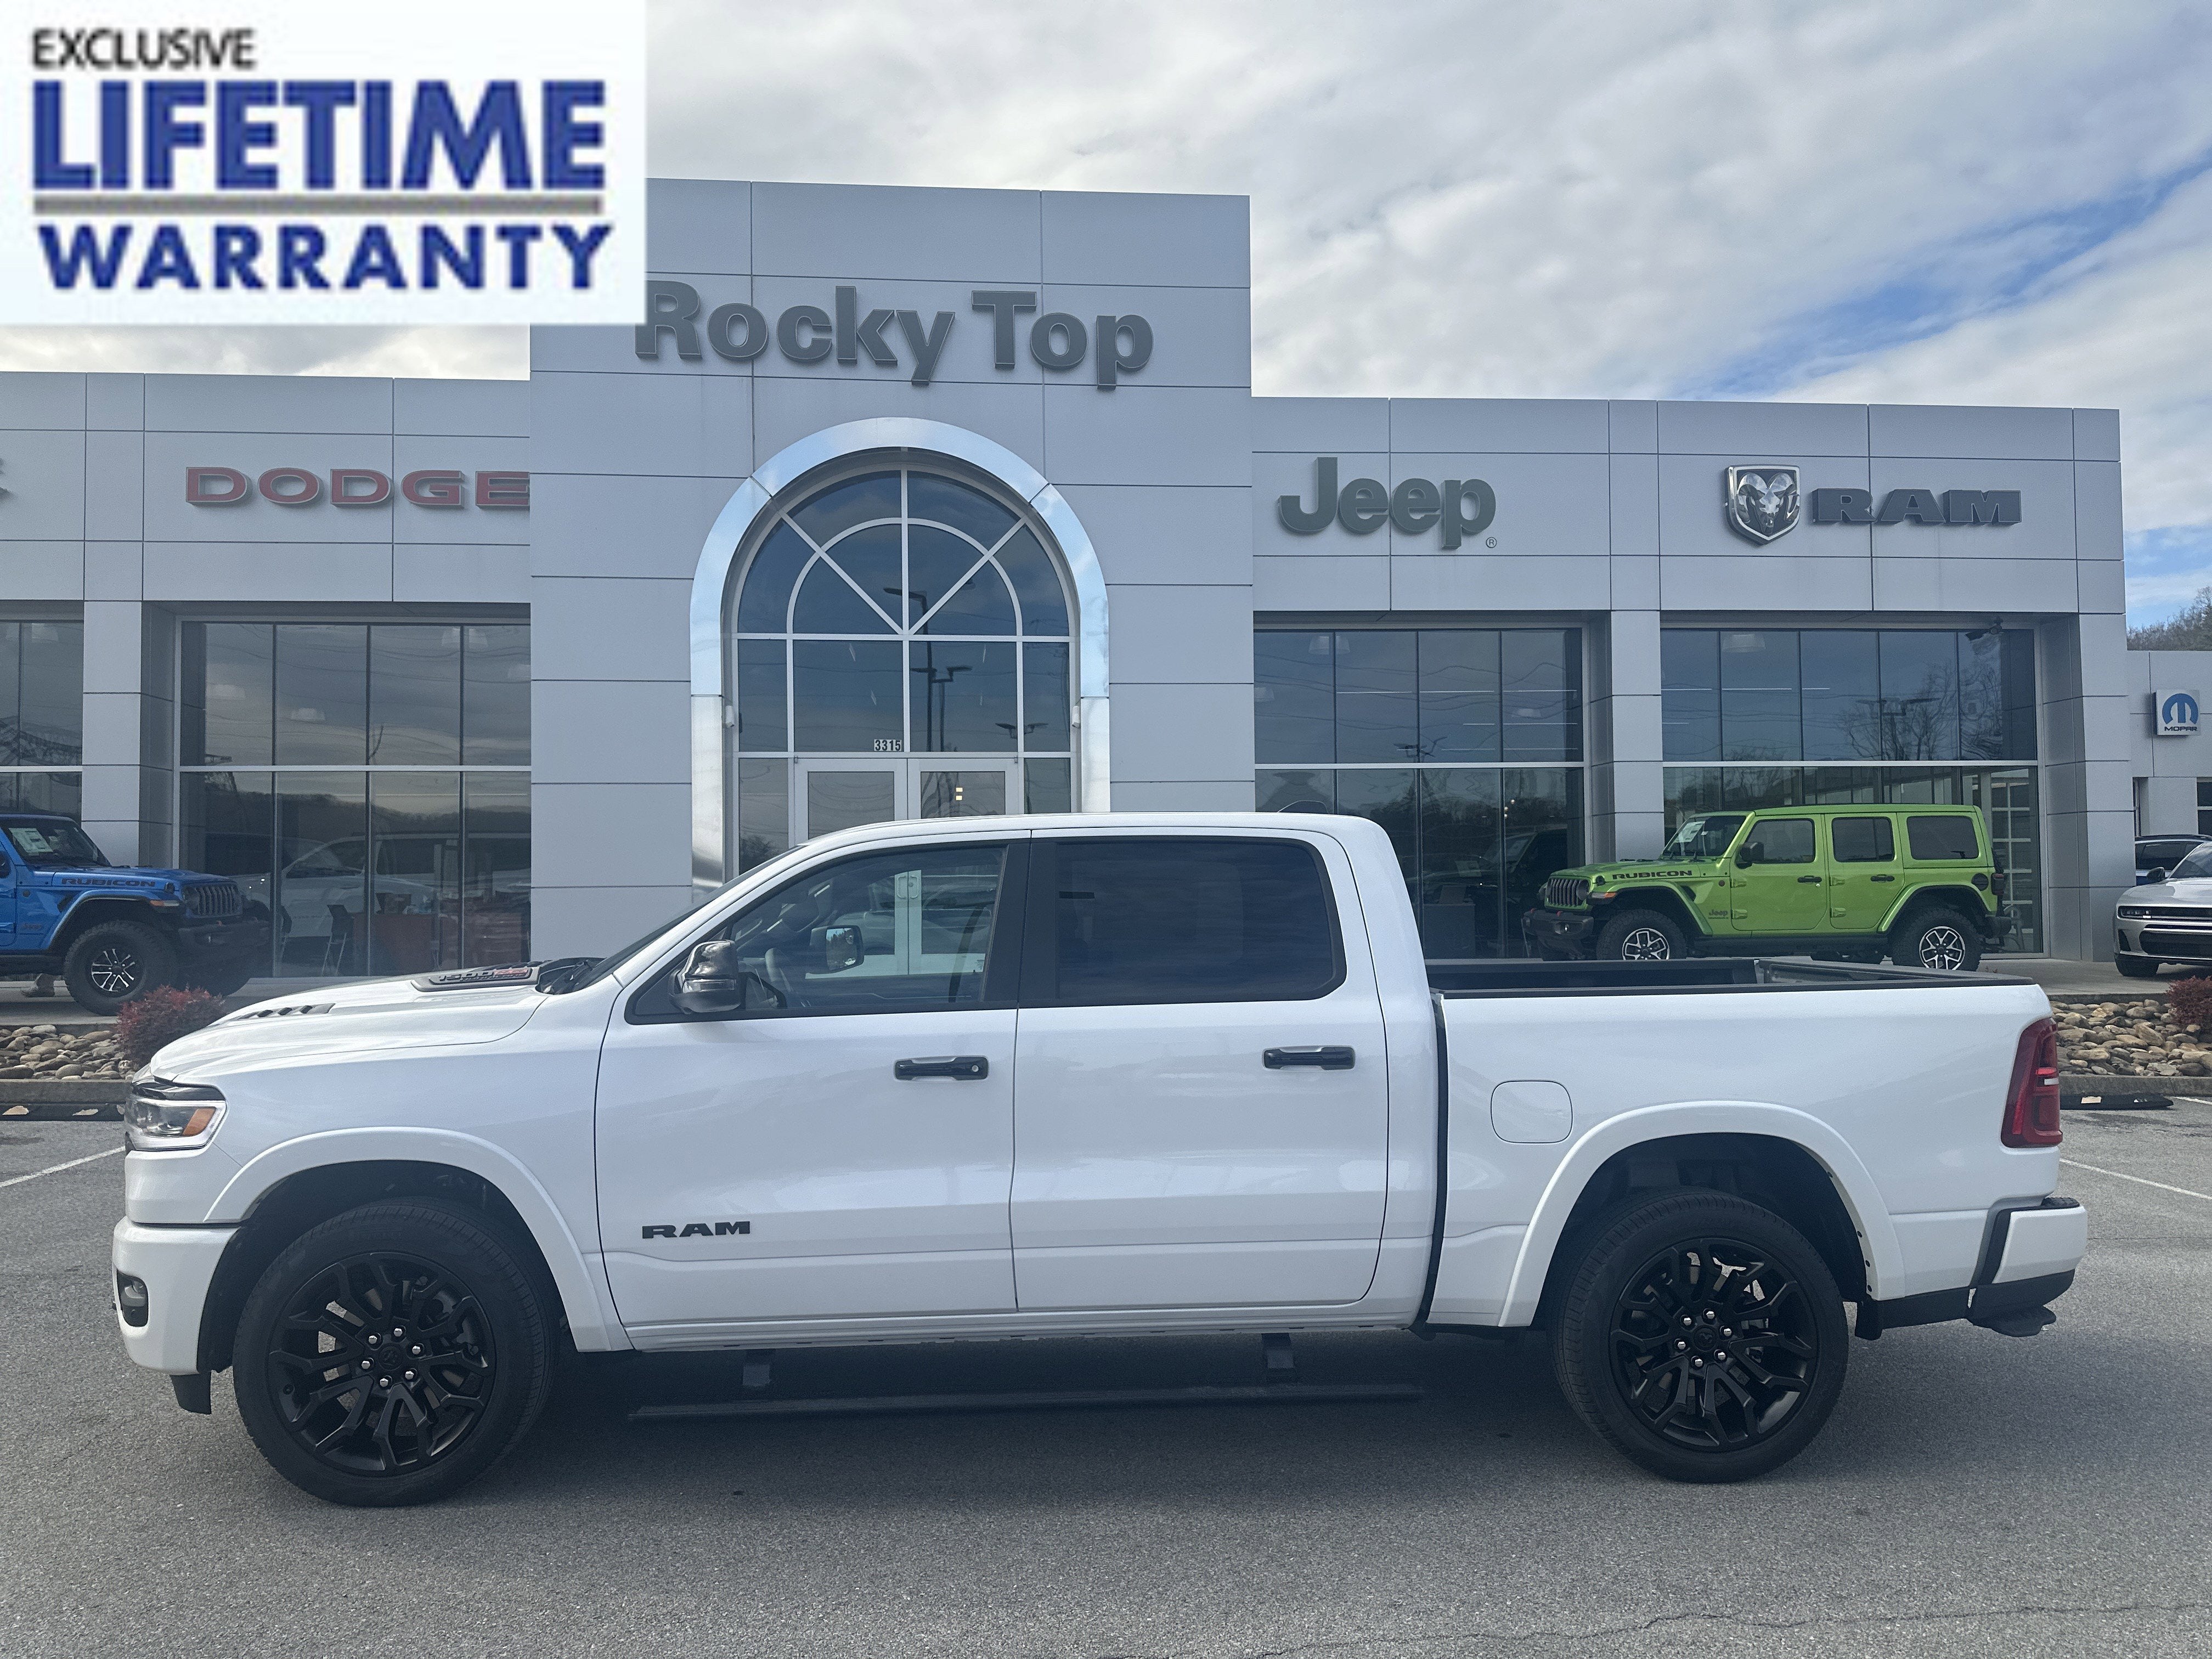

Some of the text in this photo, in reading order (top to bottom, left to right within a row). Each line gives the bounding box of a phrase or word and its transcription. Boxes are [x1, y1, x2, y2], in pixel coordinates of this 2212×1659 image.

[634, 280, 1154, 389] Rocky Top
[185, 466, 530, 508] DODGE
[1278, 457, 1496, 549] Jeep
[1812, 488, 2022, 526] RAM
[874, 740, 901, 752] 3315
[61, 878, 155, 887] RUBICON
[1612, 870, 1692, 880] RUBICON
[642, 1221, 750, 1239] RAM
